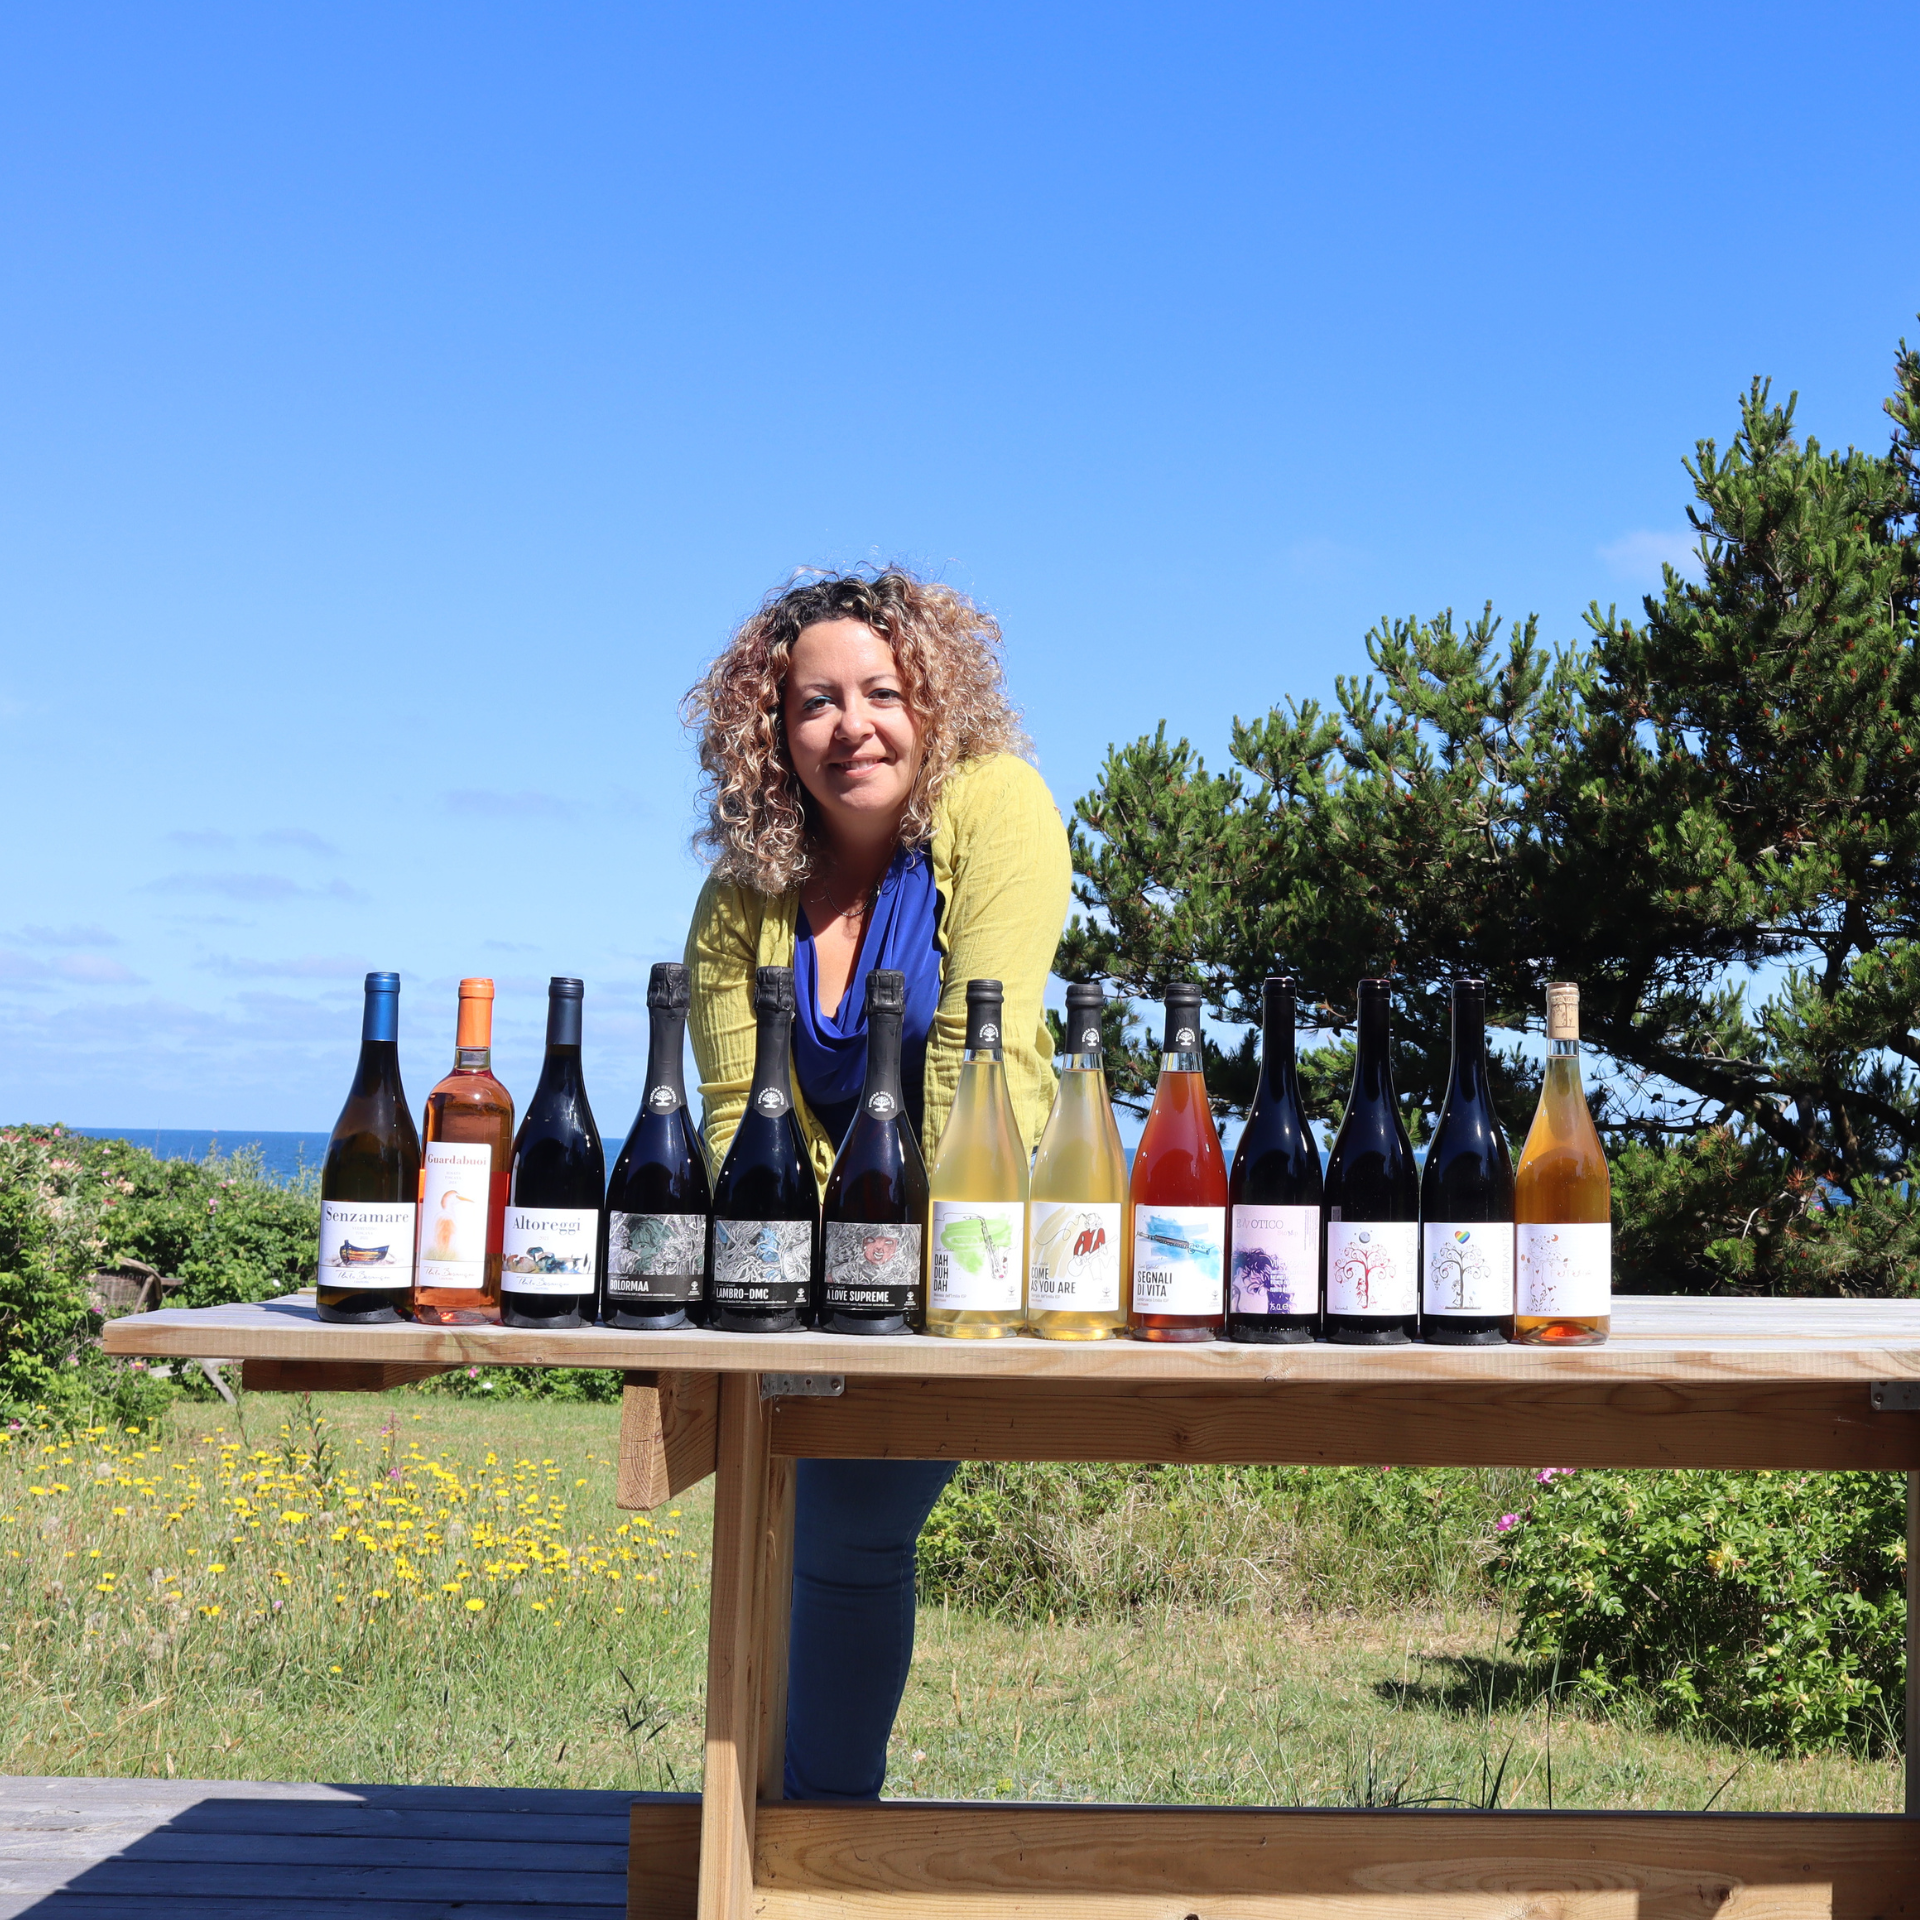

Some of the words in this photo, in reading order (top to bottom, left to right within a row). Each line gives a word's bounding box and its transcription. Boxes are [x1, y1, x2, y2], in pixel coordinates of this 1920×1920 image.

[427, 1153, 487, 1166] Guardabuoi
[325, 1206, 409, 1223] Senzamare
[512, 1215, 581, 1236] Altoreggi
[934, 1253, 949, 1266] DAH
[934, 1266, 949, 1279] DUH
[1031, 1266, 1049, 1280] COME
[1137, 1270, 1172, 1284] SEGNALI
[609, 1279, 649, 1292] BOLORMAA
[933, 1279, 948, 1292] DAH
[1030, 1280, 1038, 1292] AS
[1039, 1280, 1055, 1293] YOU
[1058, 1281, 1076, 1294] ARE
[1137, 1283, 1145, 1296] DI
[1146, 1284, 1167, 1297] VITA
[716, 1287, 769, 1300] LAMBRO-DMC
[826, 1288, 831, 1300] A
[831, 1289, 848, 1301] LOVE
[849, 1290, 889, 1303] SUPREME
